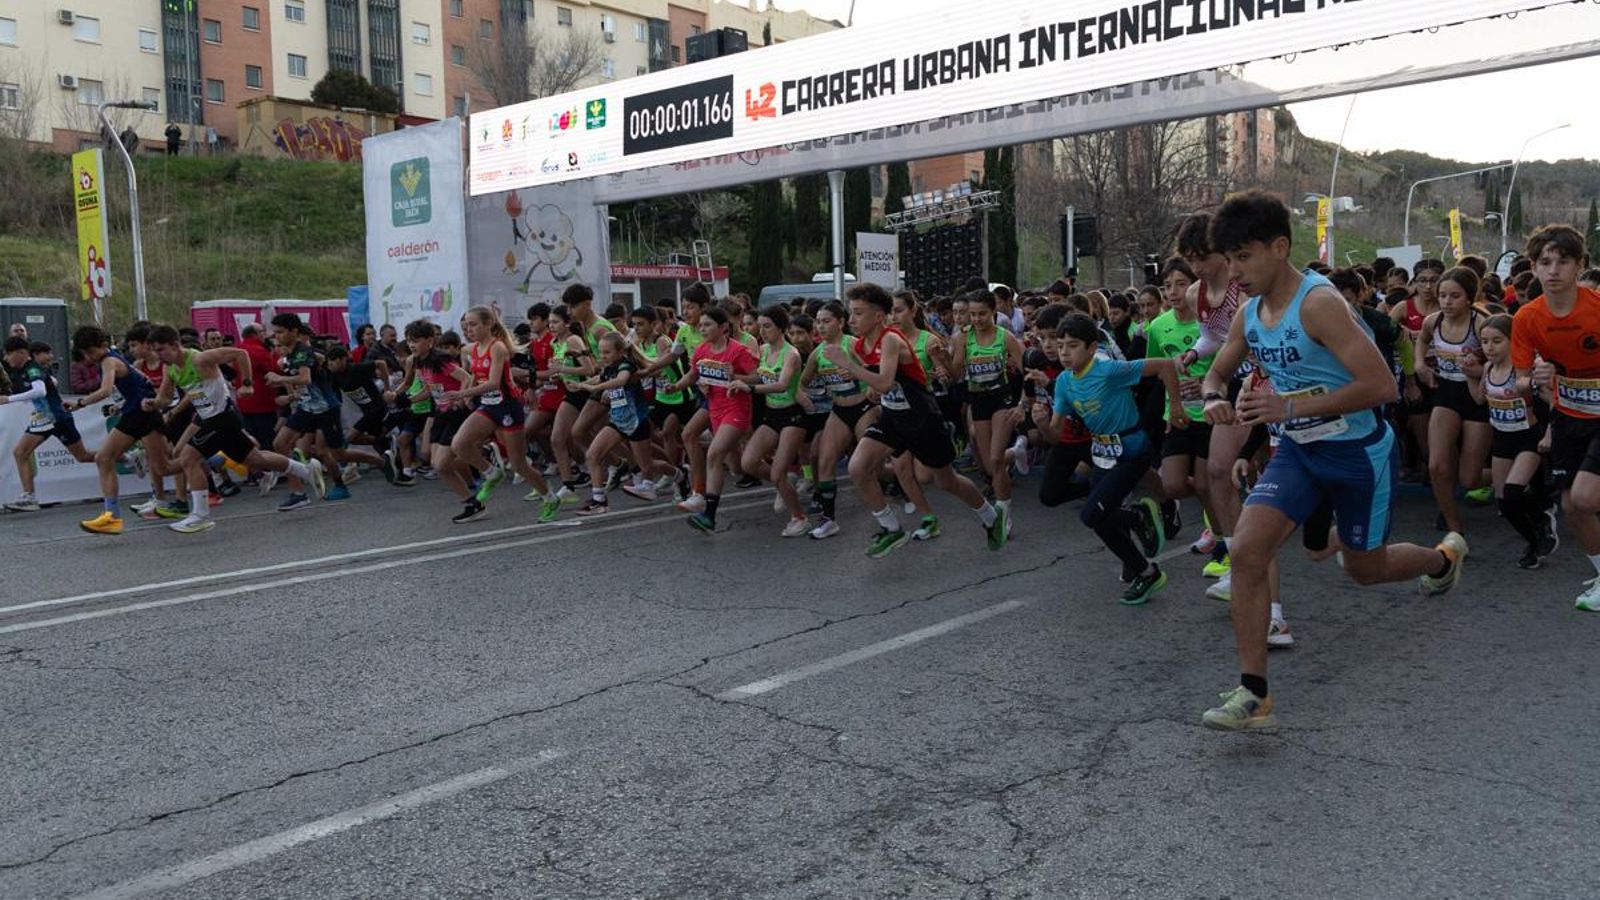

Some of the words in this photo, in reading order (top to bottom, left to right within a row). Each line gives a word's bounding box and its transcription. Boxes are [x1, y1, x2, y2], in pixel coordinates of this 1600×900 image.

[745, 82, 776, 120] 42
[782, 58, 895, 116] CARRERA
[903, 33, 1011, 92] URBANA
[630, 92, 732, 139] 00:00:01.166
[387, 240, 439, 258] calderón
[860, 250, 894, 261] ATENCIÓN
[865, 262, 891, 272] MEDIOS
[37, 449, 70, 459] DIPUTA
